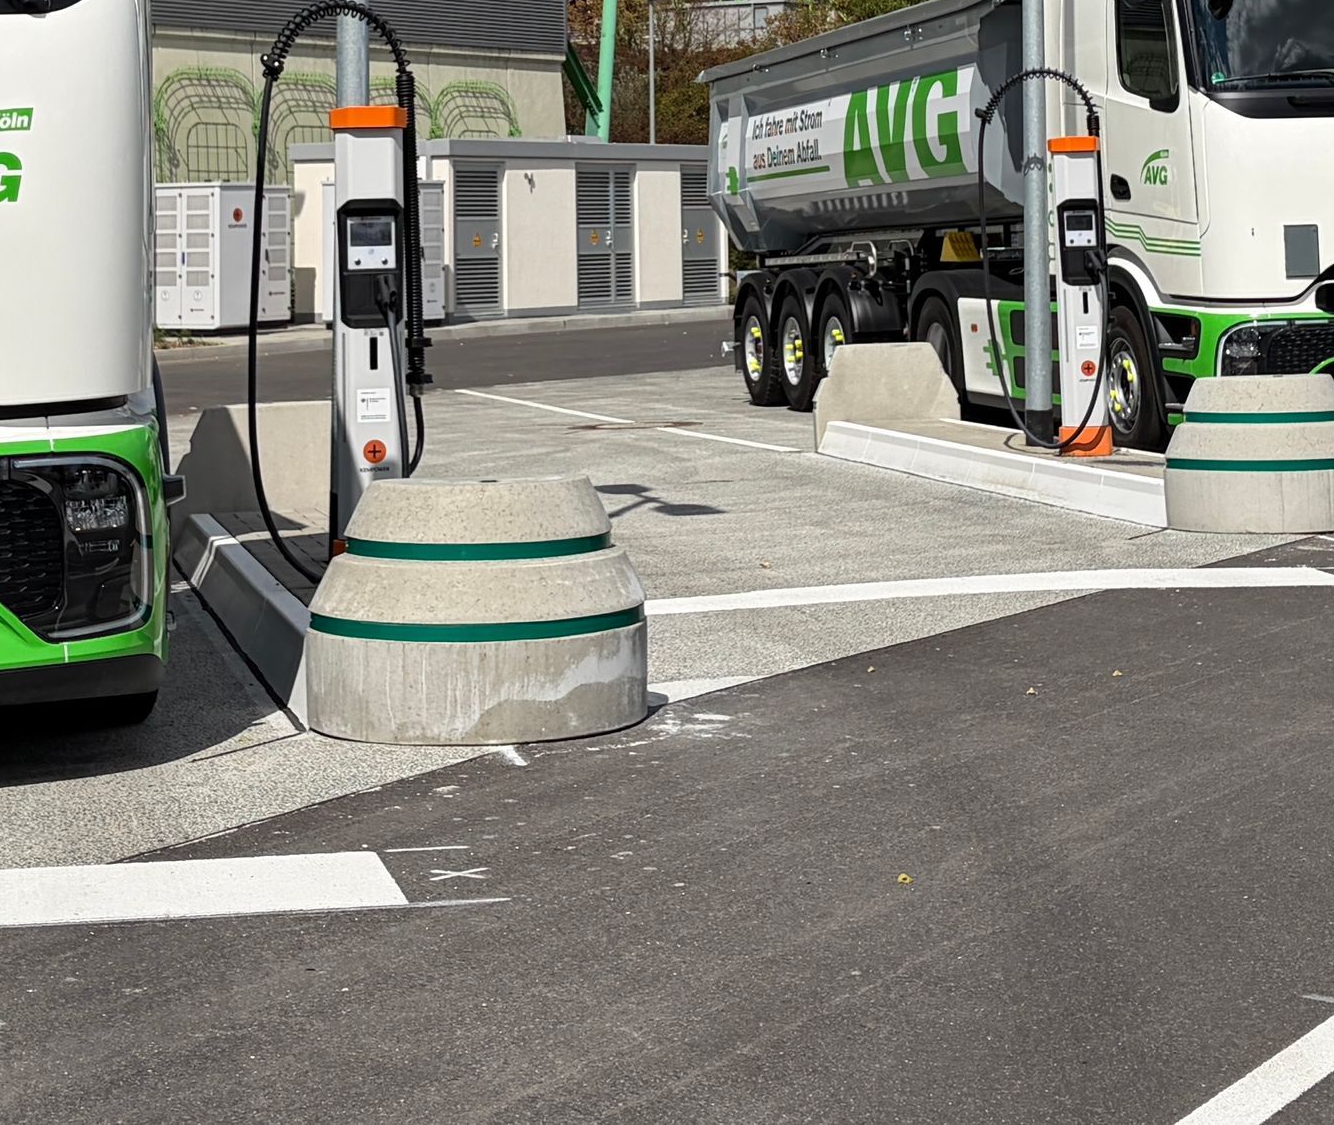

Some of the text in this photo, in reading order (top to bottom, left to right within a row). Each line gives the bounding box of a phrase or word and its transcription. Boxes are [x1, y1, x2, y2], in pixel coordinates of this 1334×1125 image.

[752, 109, 823, 140] Ich fahre mit Strom
[843, 68, 969, 188] AVG
[753, 138, 822, 170] aus Deinem Abfall.
[1144, 165, 1168, 185] AVG
